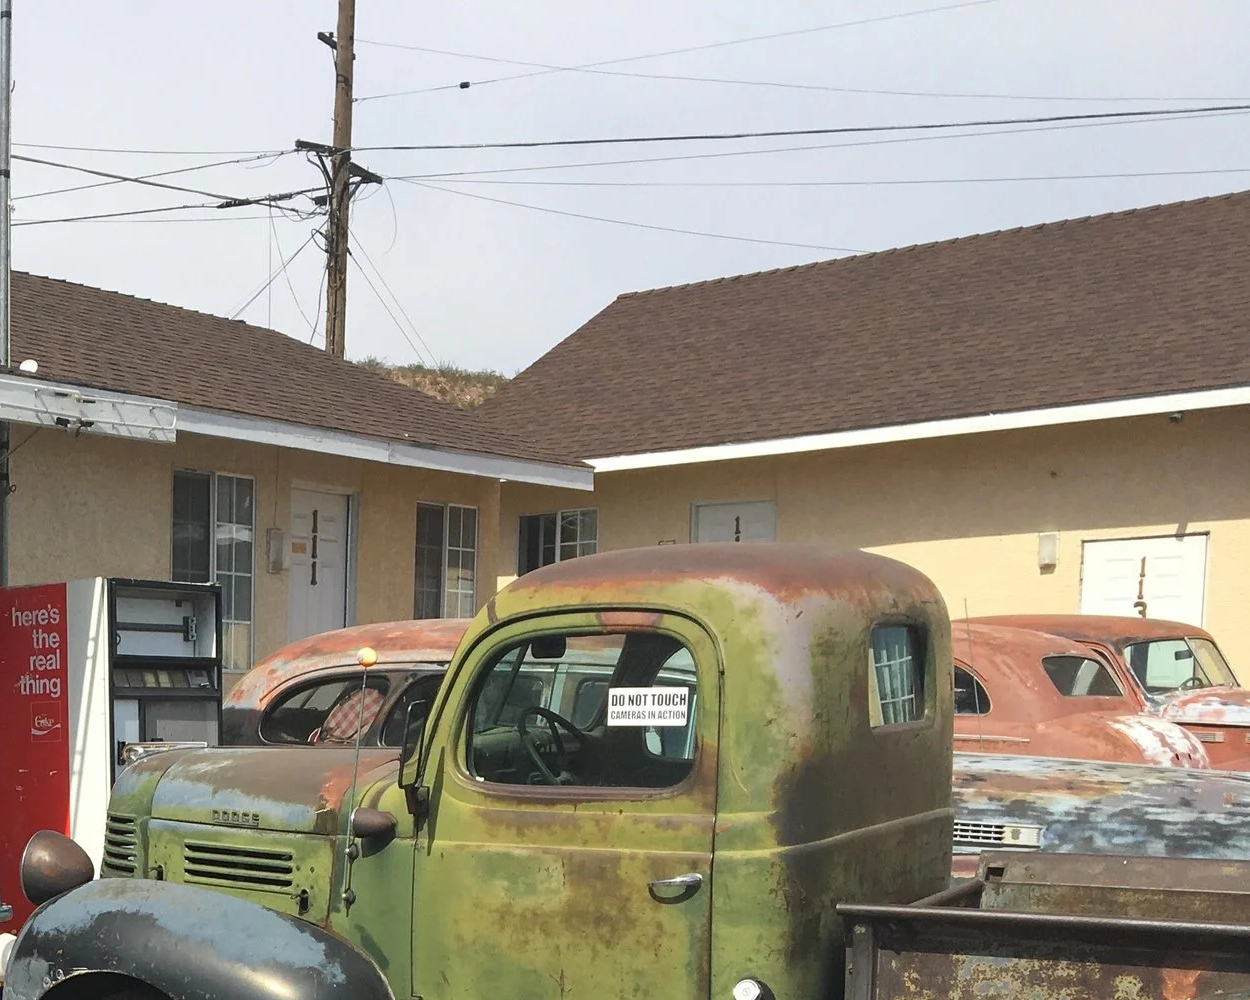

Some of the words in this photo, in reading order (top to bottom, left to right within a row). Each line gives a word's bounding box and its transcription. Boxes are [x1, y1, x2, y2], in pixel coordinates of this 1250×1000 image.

[12, 603, 60, 627] here's
[32, 630, 60, 649] the
[30, 650, 60, 672] real
[20, 675, 61, 698] thing
[611, 695, 625, 706] DO
[628, 694, 648, 706] NOT
[651, 694, 686, 706] TOUCH
[611, 710, 646, 720] CAMERAS
[648, 710, 655, 720] IN
[657, 710, 686, 720] ACTION
[212, 809, 260, 823] DODGE
